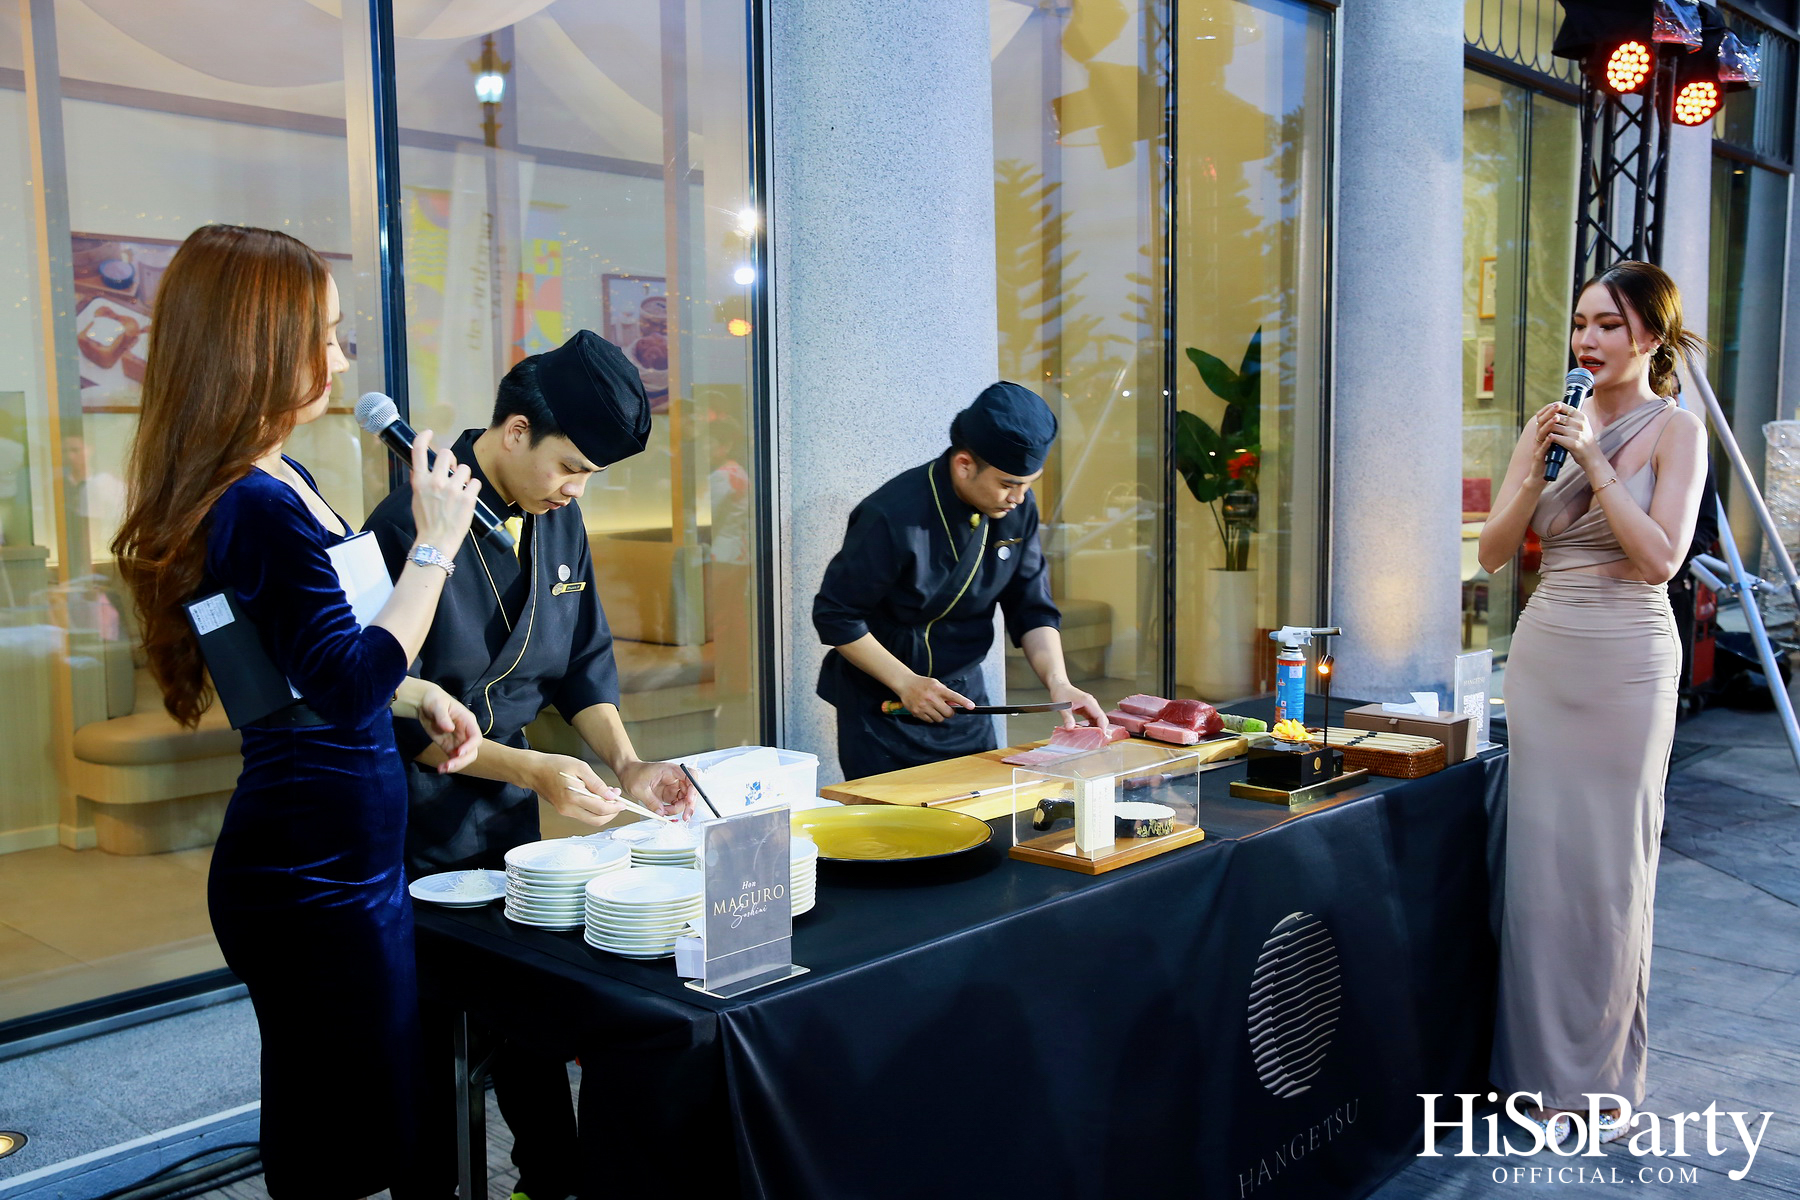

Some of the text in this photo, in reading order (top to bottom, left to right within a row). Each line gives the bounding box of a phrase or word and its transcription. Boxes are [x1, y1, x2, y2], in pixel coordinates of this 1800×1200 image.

[714, 884, 785, 916] MAGURO
[742, 880, 757, 890] Hon
[1239, 1099, 1359, 1199] HANGETSU
